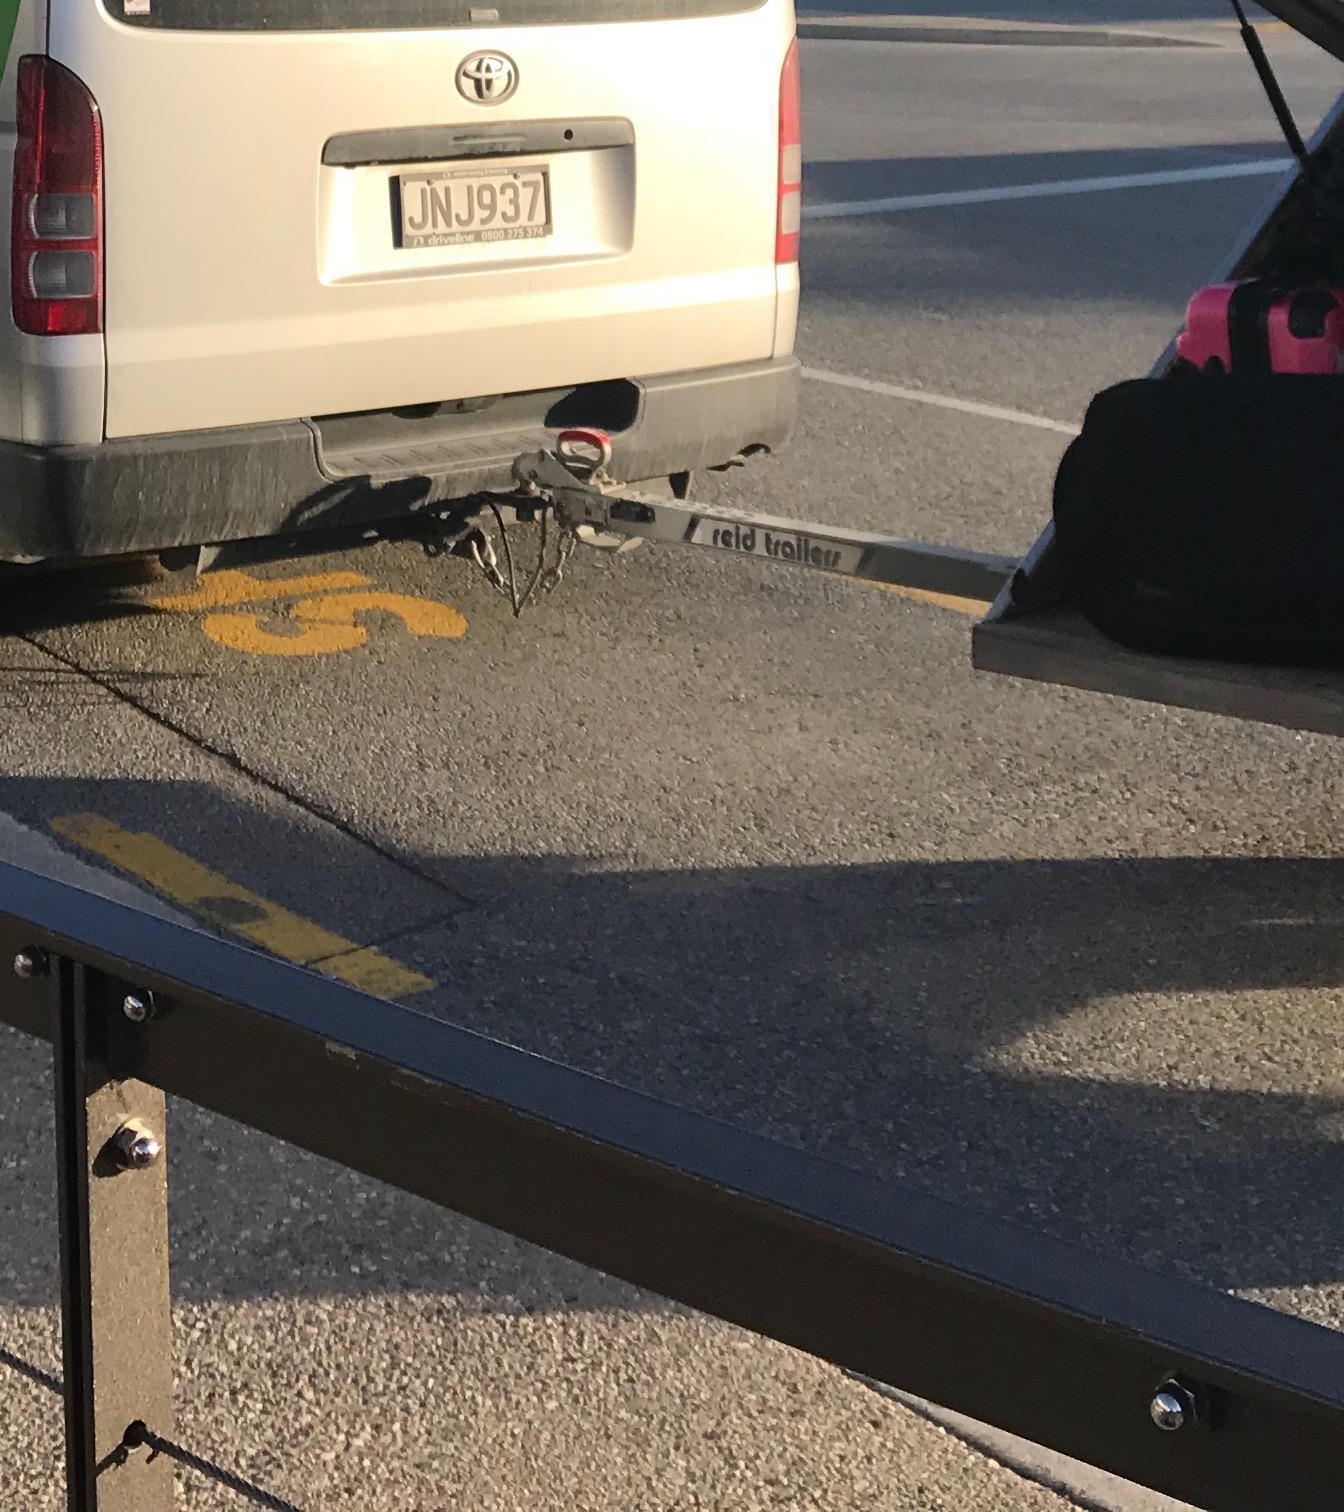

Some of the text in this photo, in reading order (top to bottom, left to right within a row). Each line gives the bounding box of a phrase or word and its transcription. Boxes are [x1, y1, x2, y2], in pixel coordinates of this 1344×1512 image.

[408, 179, 542, 231] JNJ937
[712, 524, 841, 568] reid trailers
